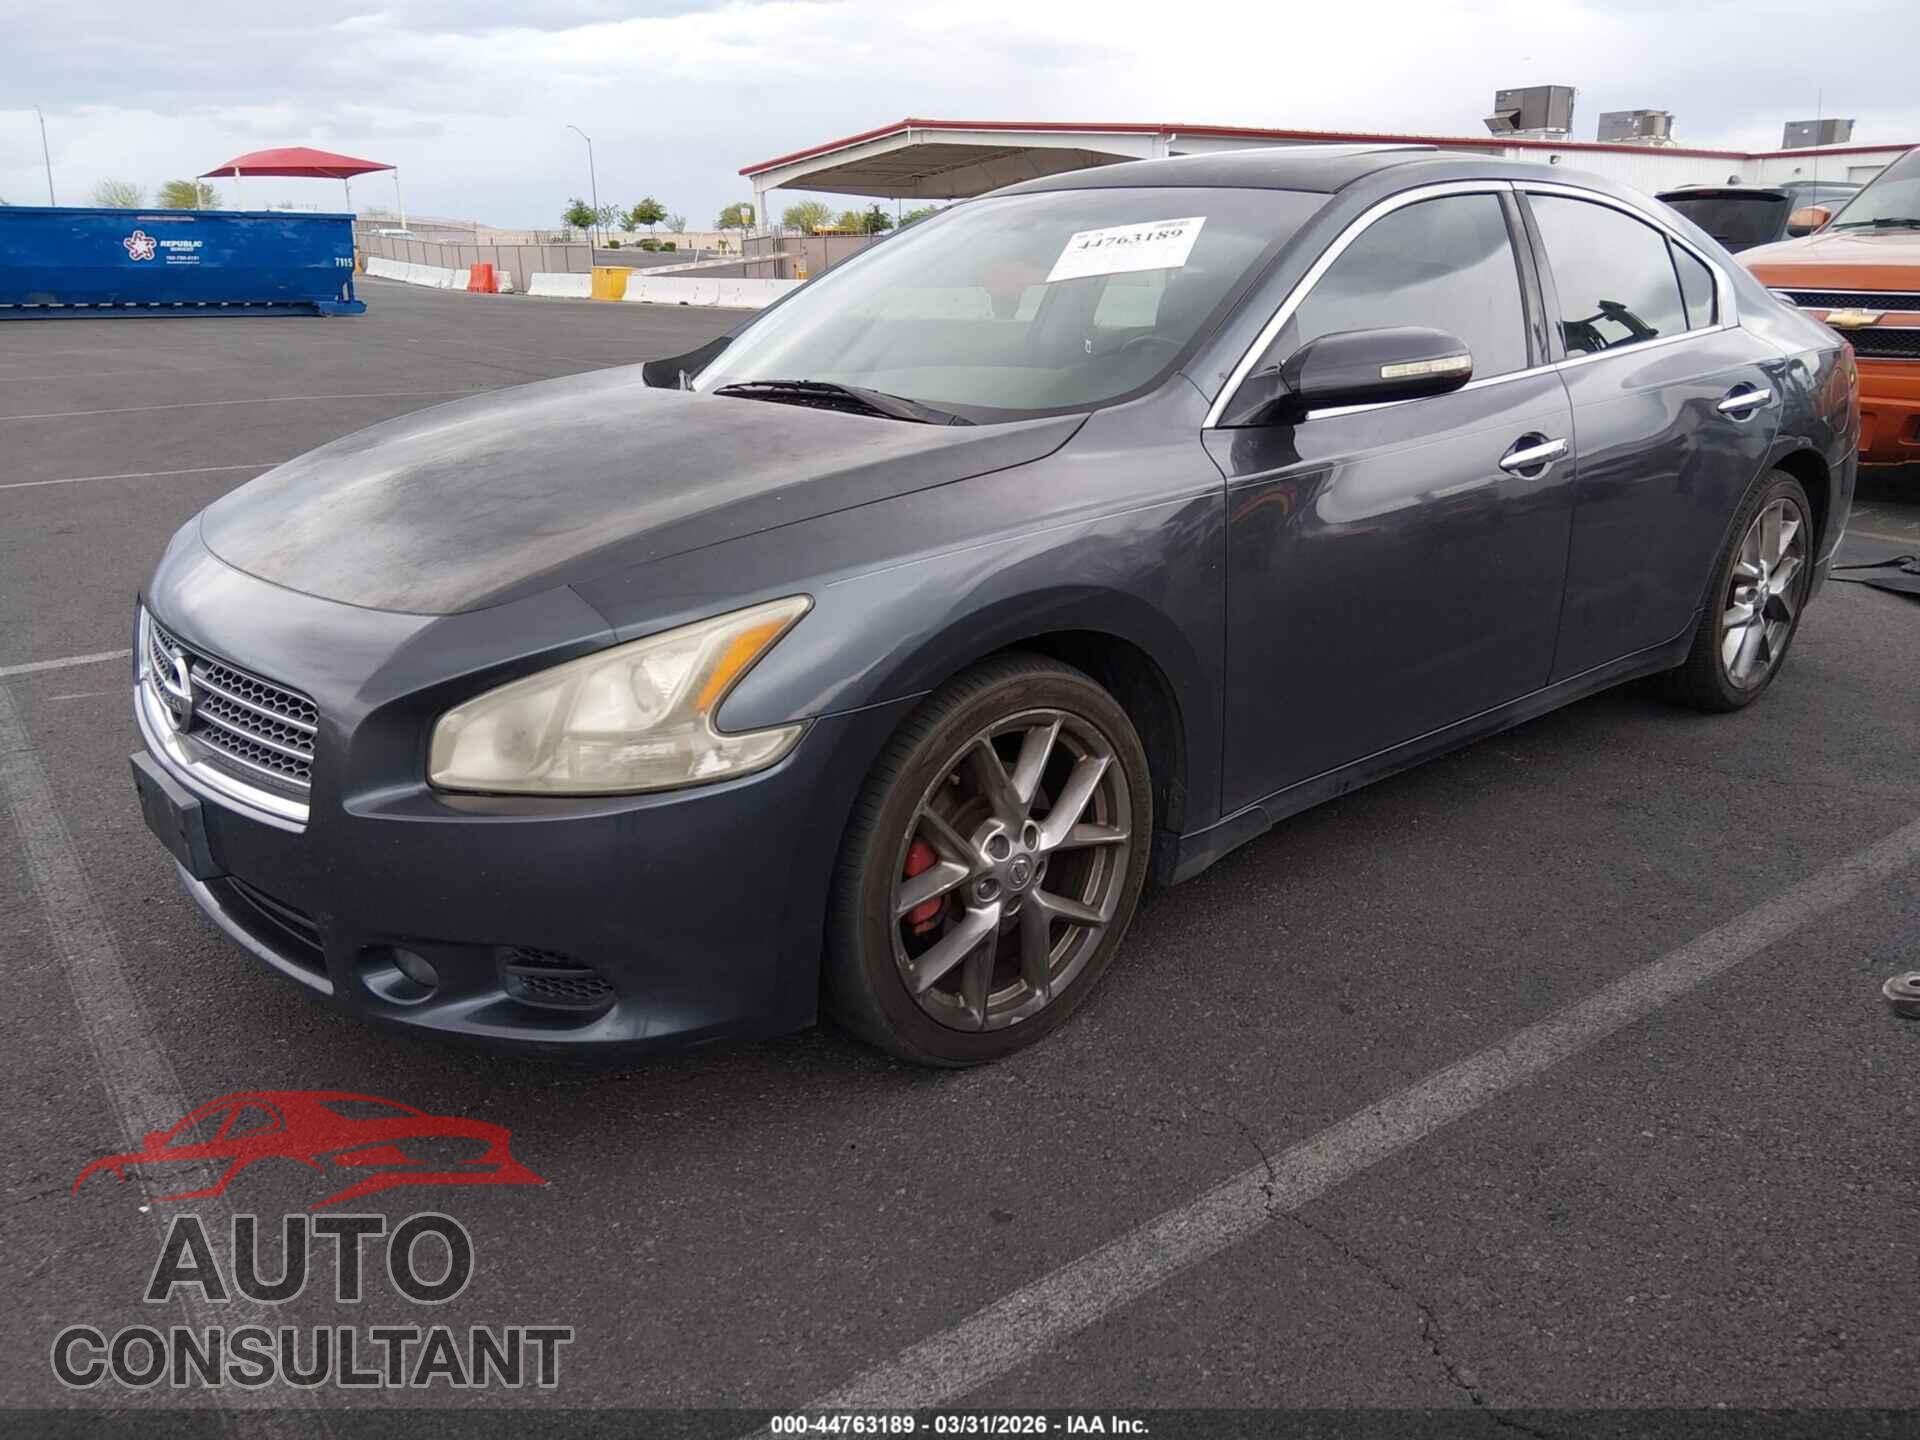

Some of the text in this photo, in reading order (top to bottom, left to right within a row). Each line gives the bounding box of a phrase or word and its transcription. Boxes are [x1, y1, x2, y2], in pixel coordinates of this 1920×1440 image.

[160, 240, 203, 248] REPUBLIC
[1076, 229, 1184, 249] 44763189
[334, 257, 353, 268] 7115
